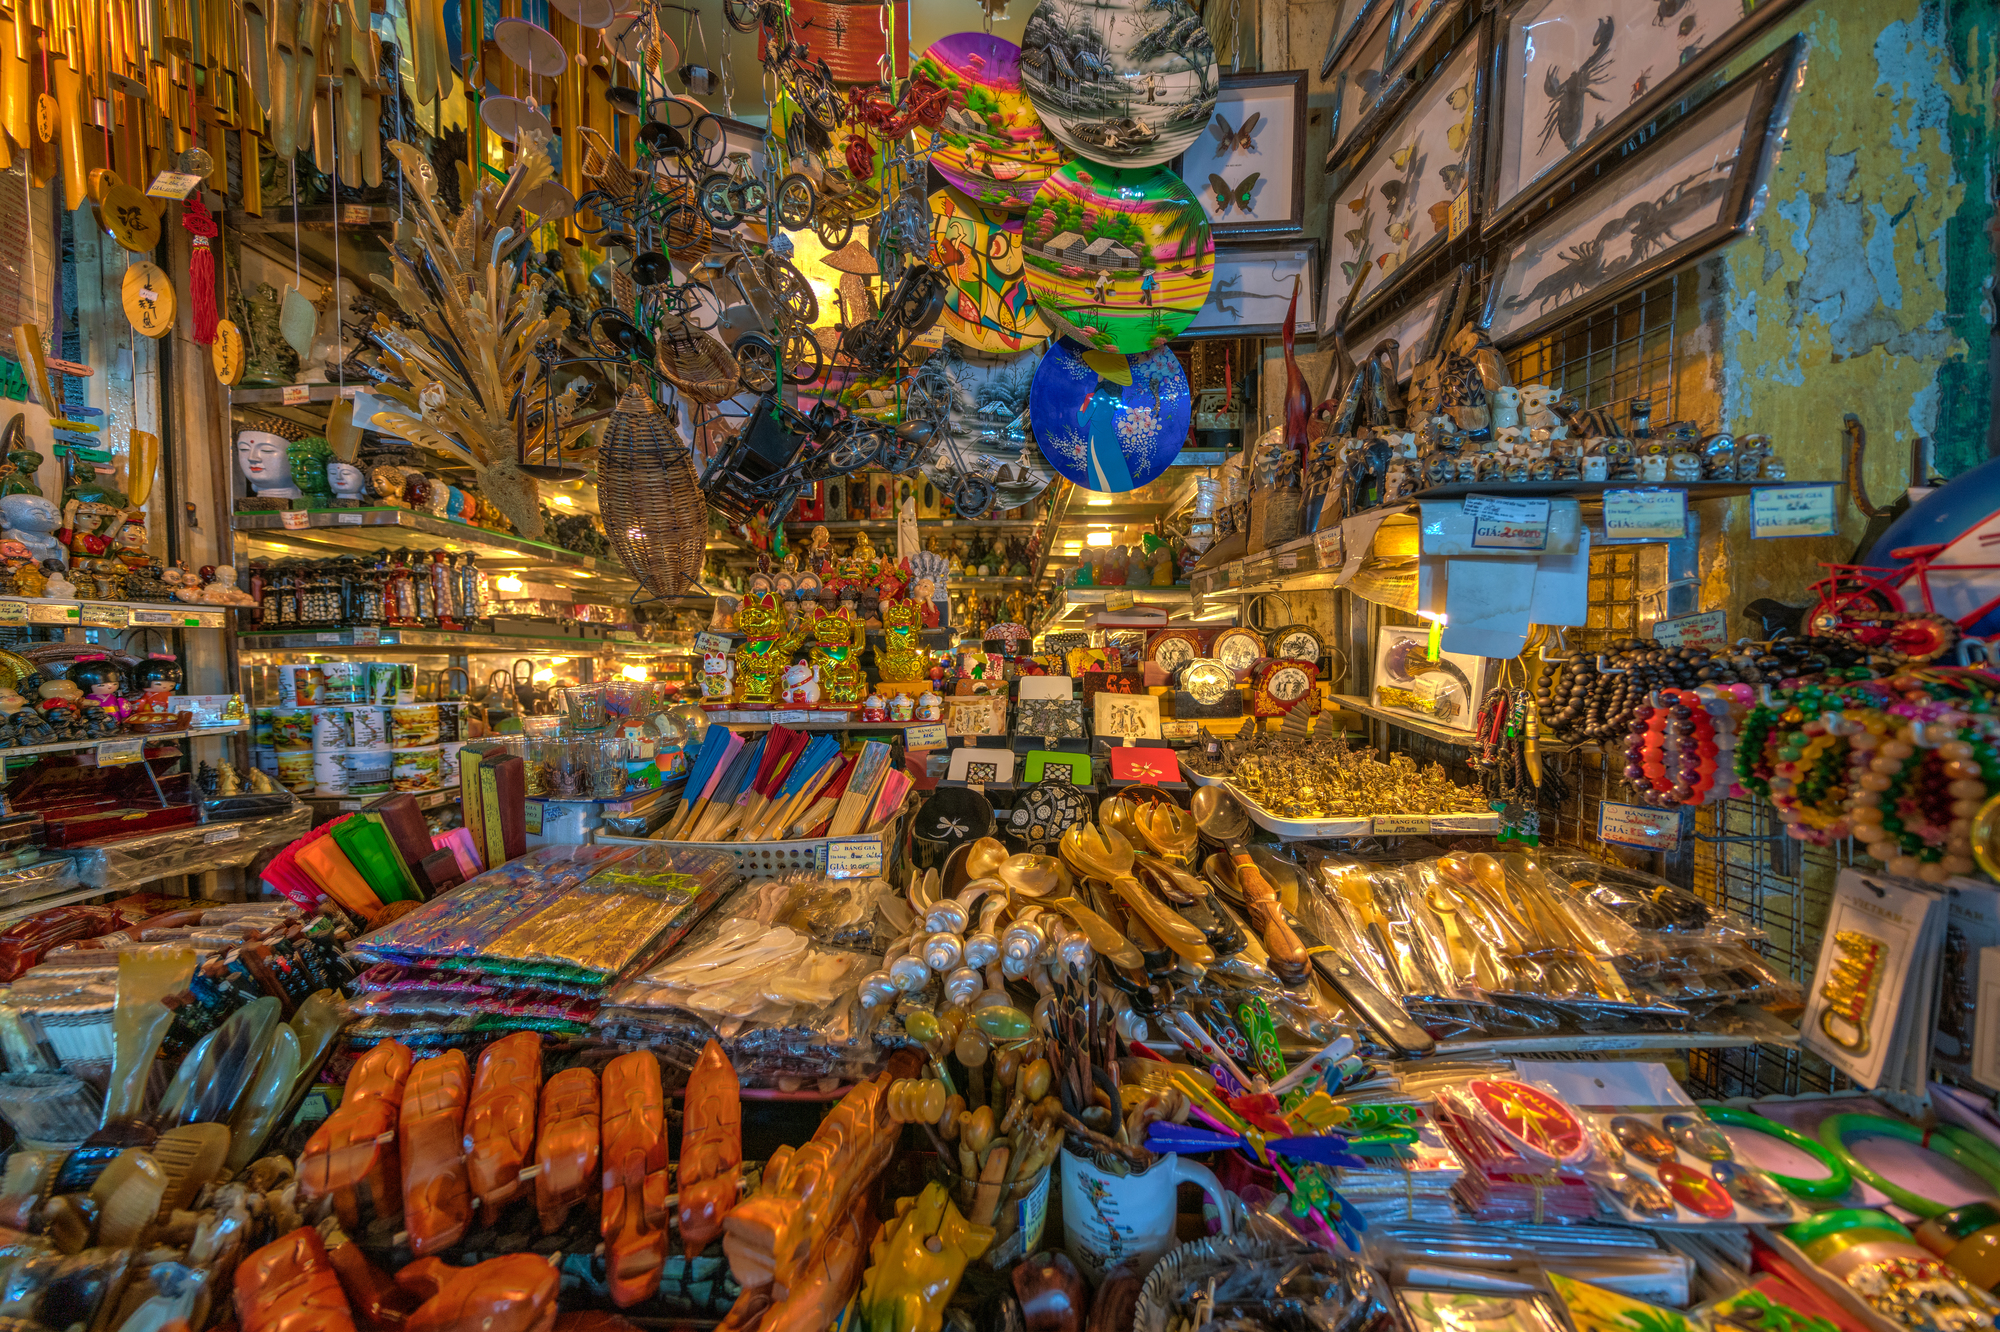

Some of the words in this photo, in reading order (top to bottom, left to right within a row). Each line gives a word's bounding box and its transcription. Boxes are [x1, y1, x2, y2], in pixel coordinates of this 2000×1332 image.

[1608, 518, 1634, 529] GIÁ:
[1478, 526, 1501, 537] GIÁ:
[1625, 810, 1650, 819] BẢNG
[1411, 817, 1425, 825] GIÁ
[1604, 825, 1628, 834] GIÁ:
[829, 861, 848, 870] GIÁ:
[1500, 1081, 1572, 1130] VIETNAM
